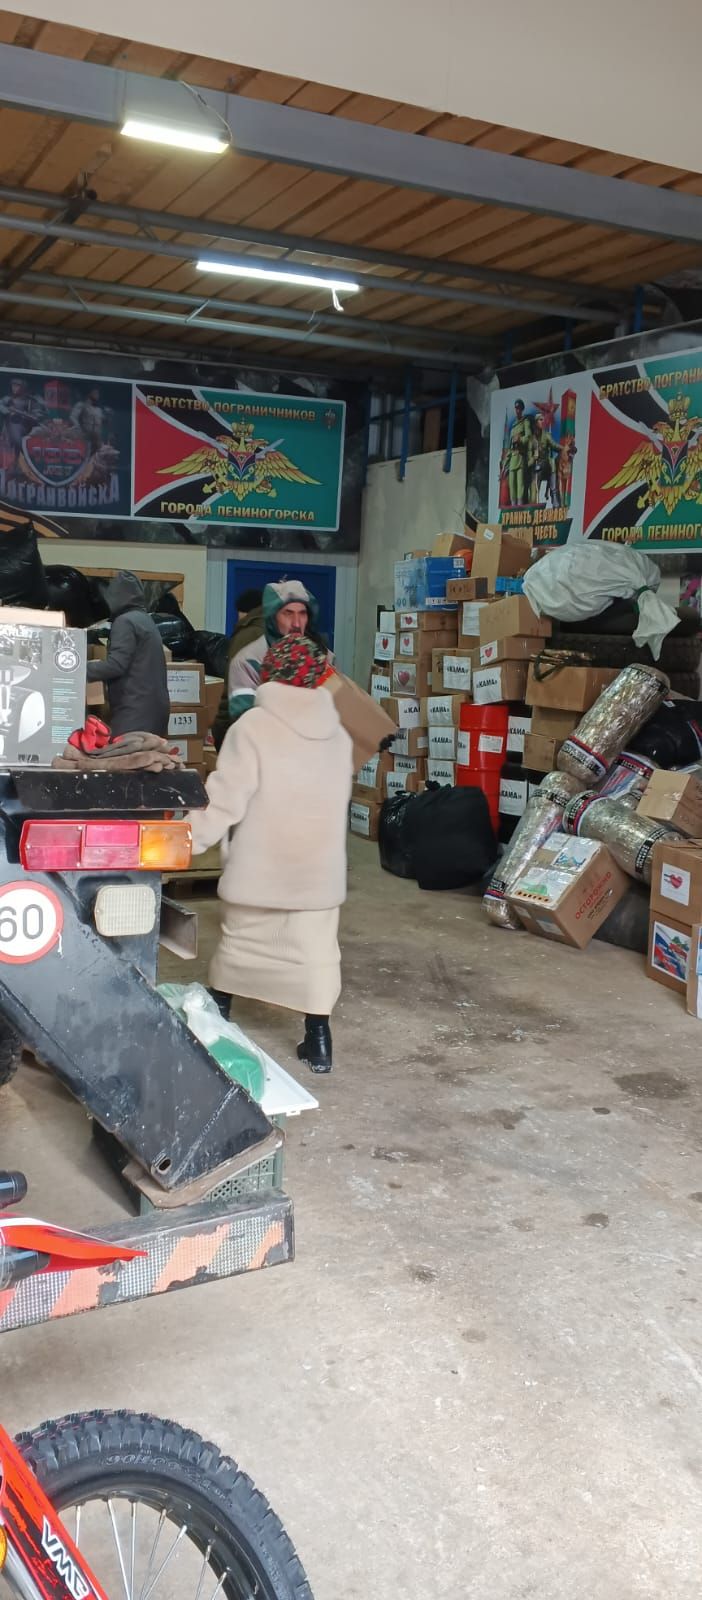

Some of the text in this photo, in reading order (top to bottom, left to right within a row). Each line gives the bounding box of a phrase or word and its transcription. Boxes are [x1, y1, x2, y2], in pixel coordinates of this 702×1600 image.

[600, 377, 651, 399] БРАТСТВО
[146, 395, 316, 421] БРАТСТВО ПОГРАНИЧНИКОВ
[160, 501, 316, 521] ГОРОДА ЛЕНИНОГОРСКА
[534, 524, 558, 540] ЧЕСТЬ
[602, 523, 702, 543] ГОРОДА ЛЕНИНОГ
[61, 654, 75, 666] 25
[174, 716, 193, 725] 1233
[575, 871, 612, 920] ОСТОРОЖНО
[0, 903, 44, 943] 60
